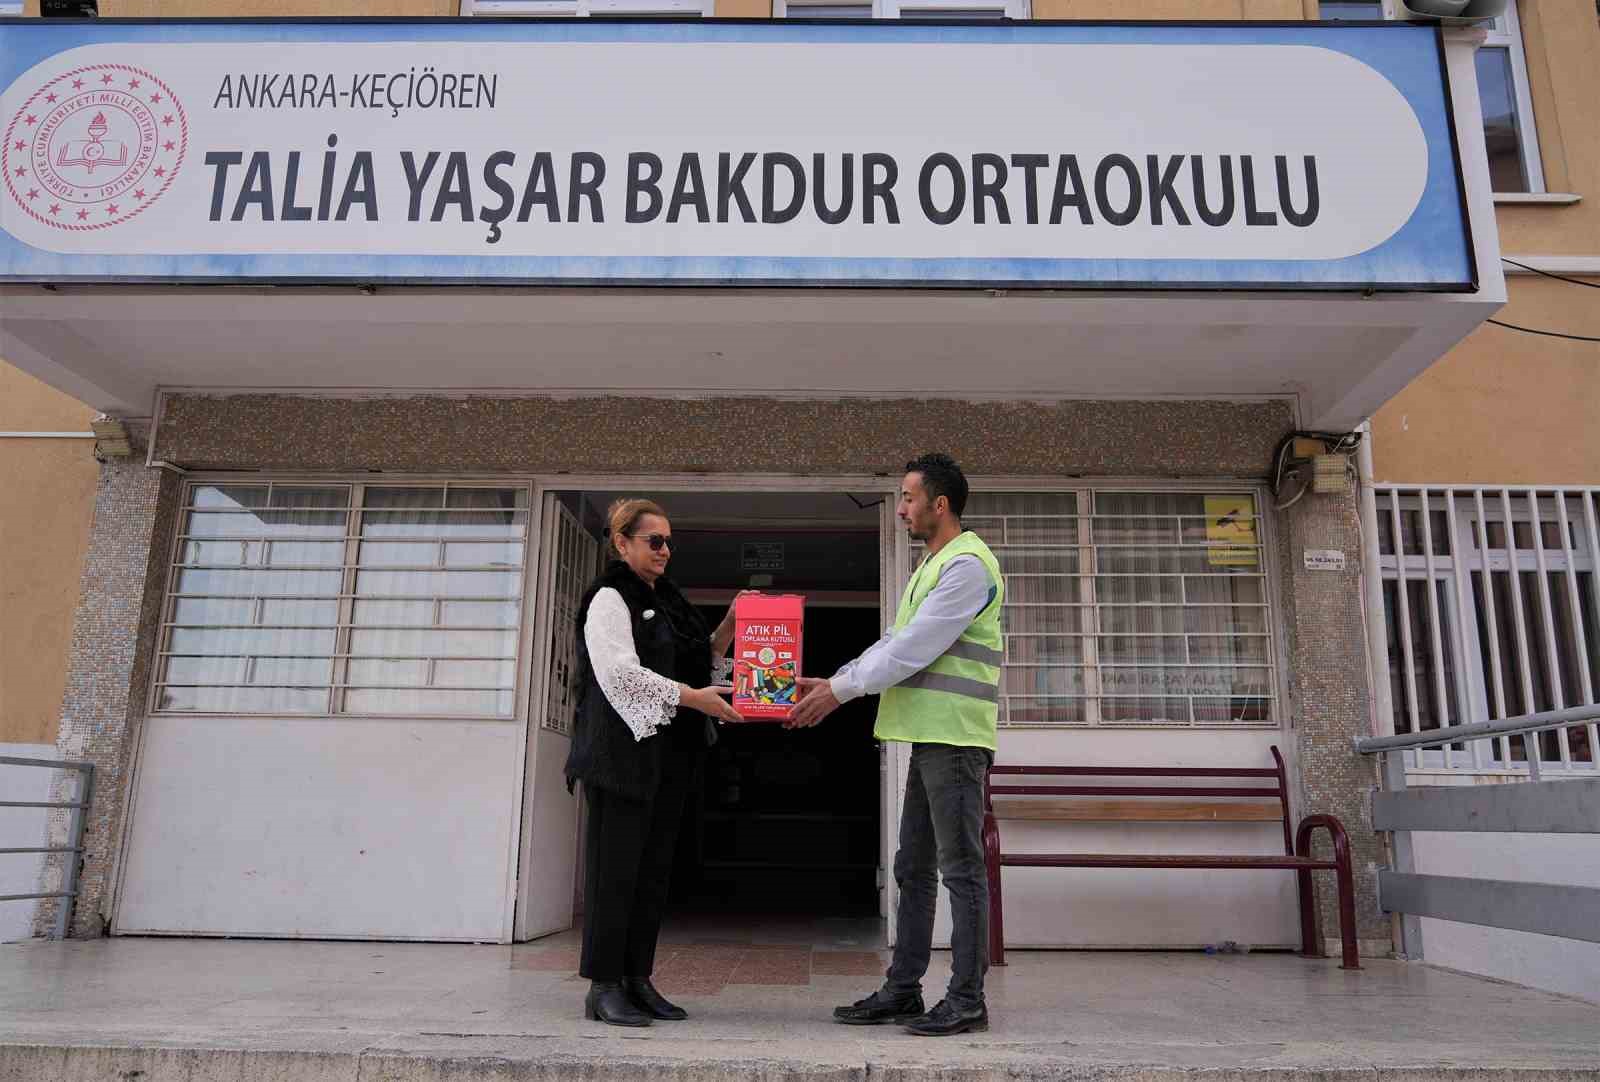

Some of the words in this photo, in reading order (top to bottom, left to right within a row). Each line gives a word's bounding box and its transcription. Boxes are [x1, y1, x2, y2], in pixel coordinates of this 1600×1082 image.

[213, 66, 498, 118] ANKARA-KEÇİÖREN
[205, 133, 379, 222] TALİA
[400, 151, 606, 244] YAŞAR
[626, 151, 901, 225] BAKDUR
[918, 152, 1320, 228] ORTAOKULU
[745, 624, 770, 636] ATIK
[774, 623, 791, 636] PİL
